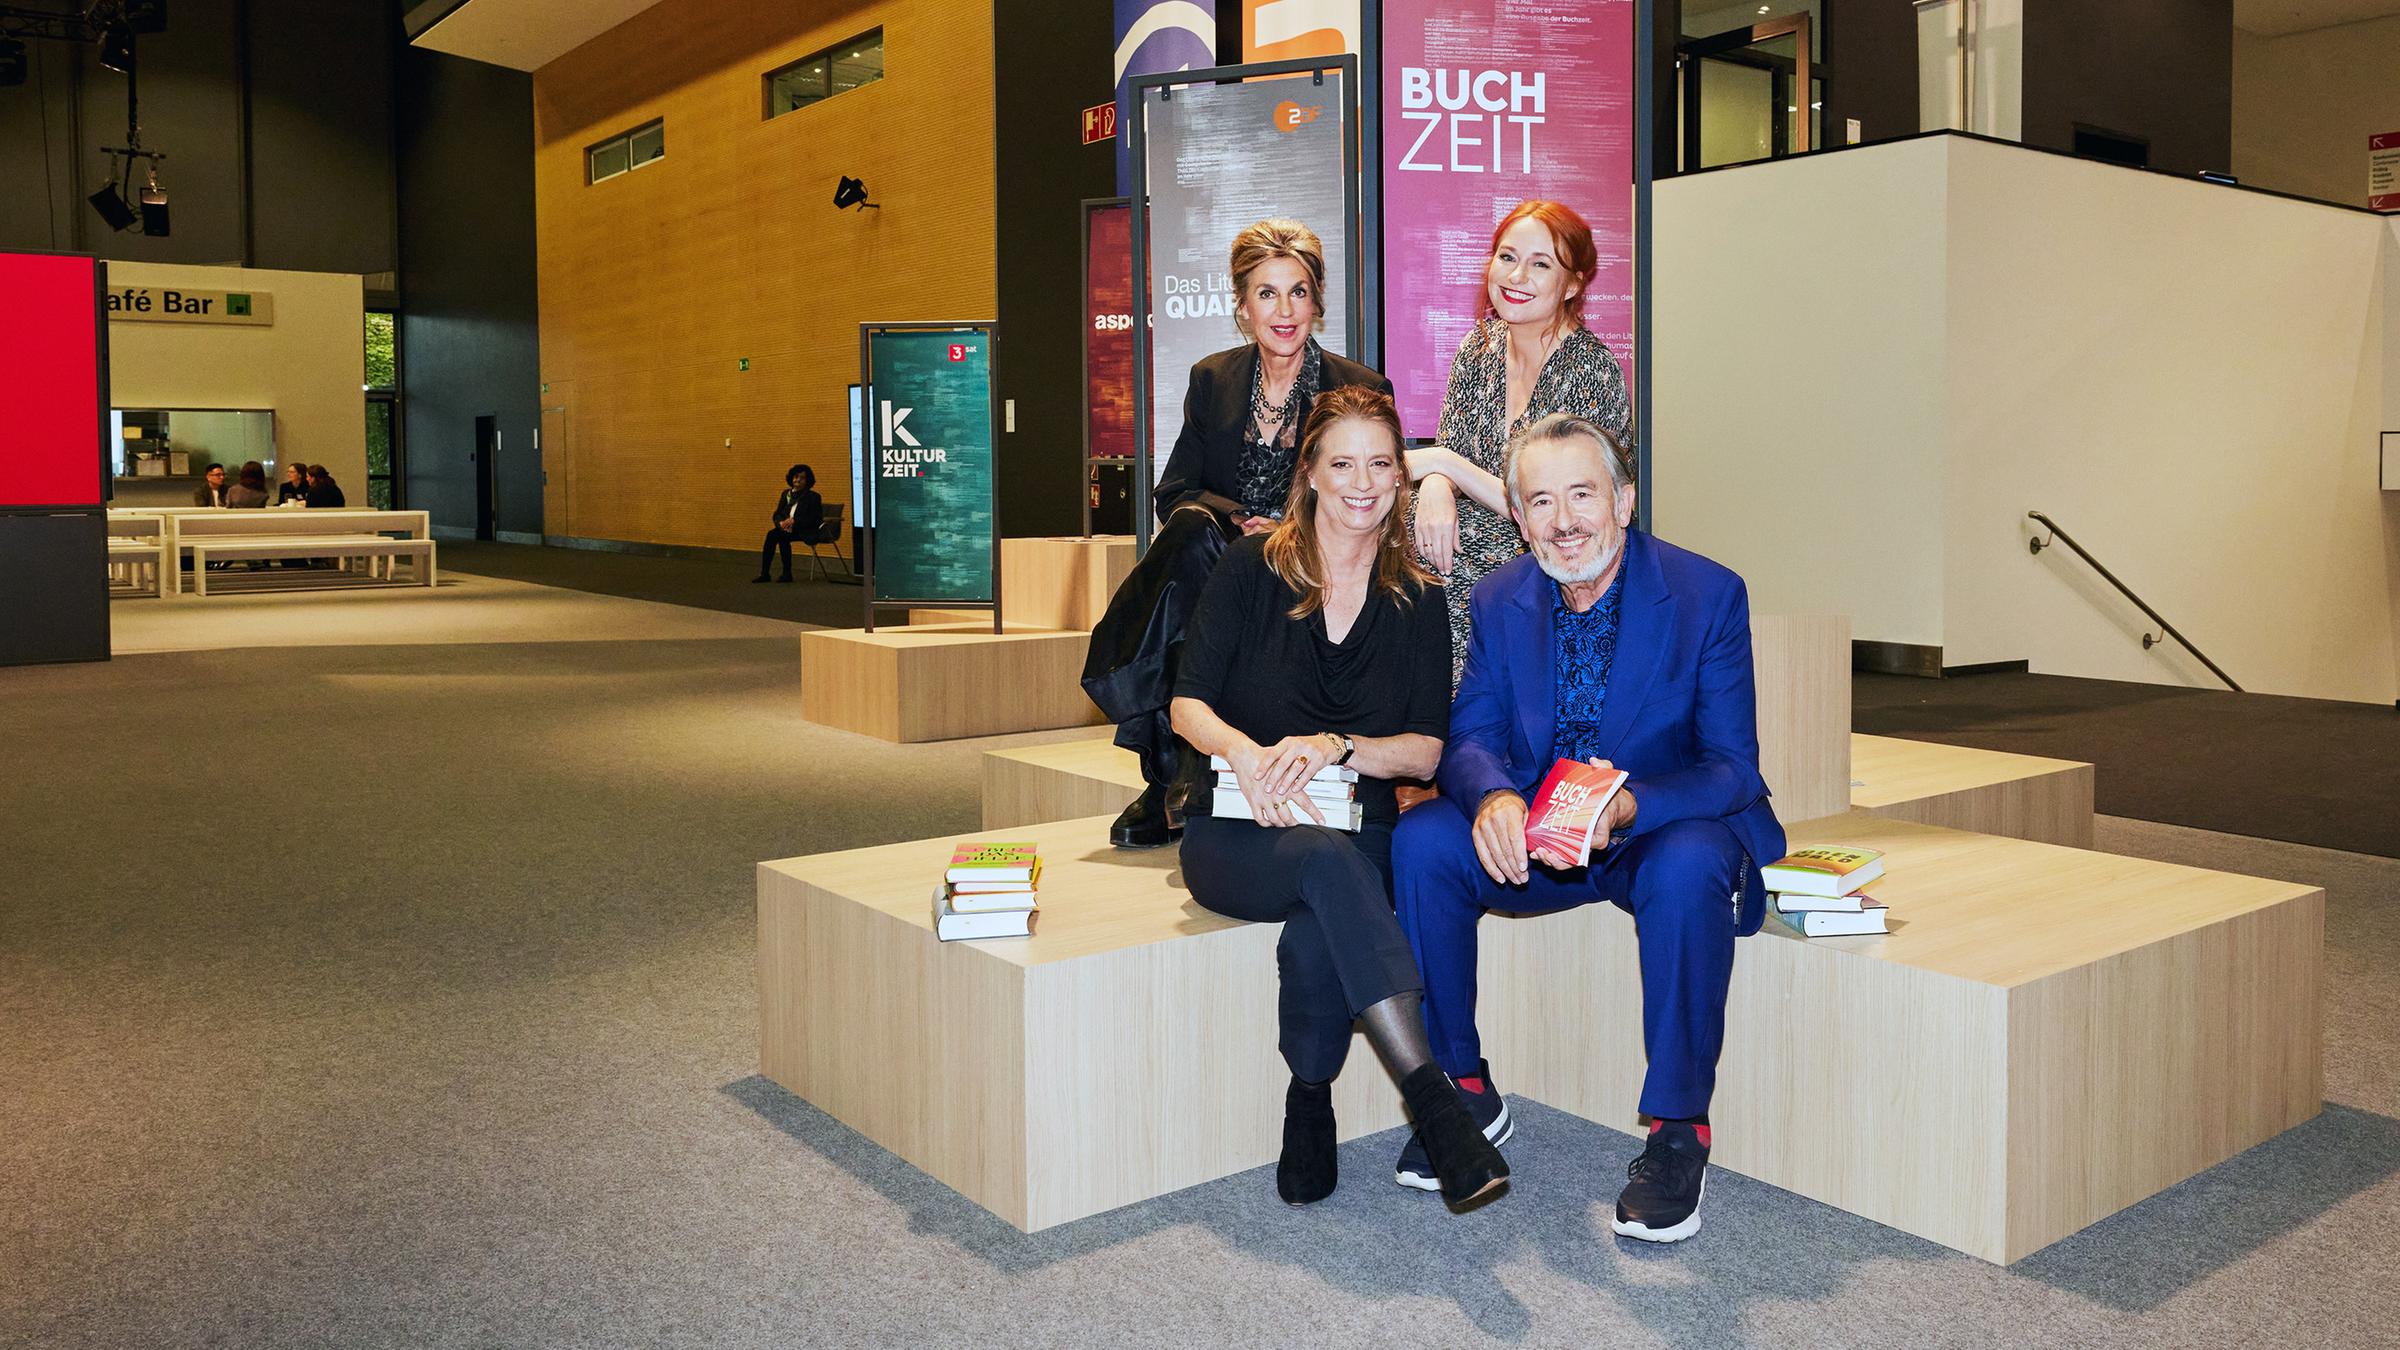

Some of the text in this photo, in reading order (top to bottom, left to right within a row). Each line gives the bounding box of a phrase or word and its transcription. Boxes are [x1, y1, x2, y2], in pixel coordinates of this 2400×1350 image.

[1402, 67, 1546, 112] BUCH
[1399, 111, 1546, 174] ZEIT
[1165, 275, 1200, 294] Das
[108, 289, 213, 314] afé Bar
[882, 449, 947, 462] KULTUR
[1551, 780, 1592, 805] BUCH
[1540, 799, 1580, 834] ZEIT
